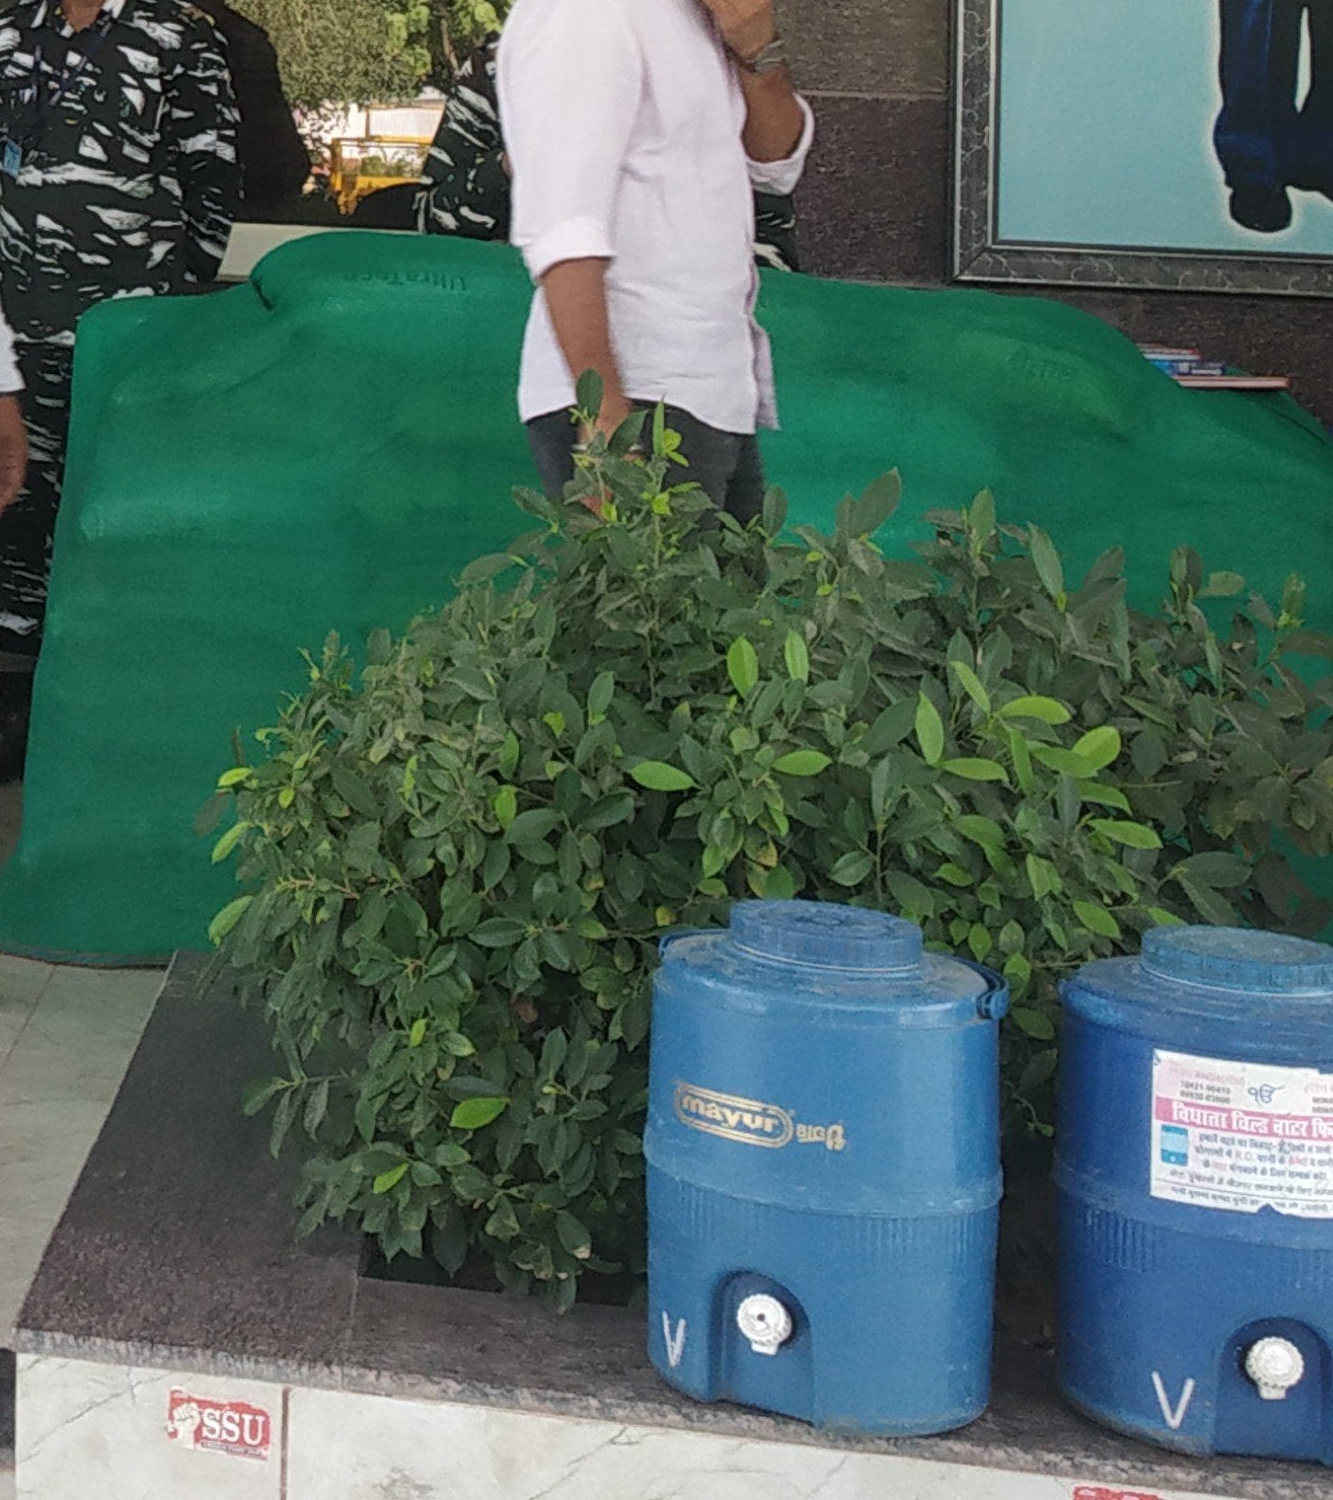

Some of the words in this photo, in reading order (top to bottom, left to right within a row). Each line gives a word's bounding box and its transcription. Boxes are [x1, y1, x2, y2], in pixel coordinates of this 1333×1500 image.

[682, 1094, 779, 1133] mayur
[1151, 1370, 1196, 1430] V
[201, 1408, 266, 1446] SSU
